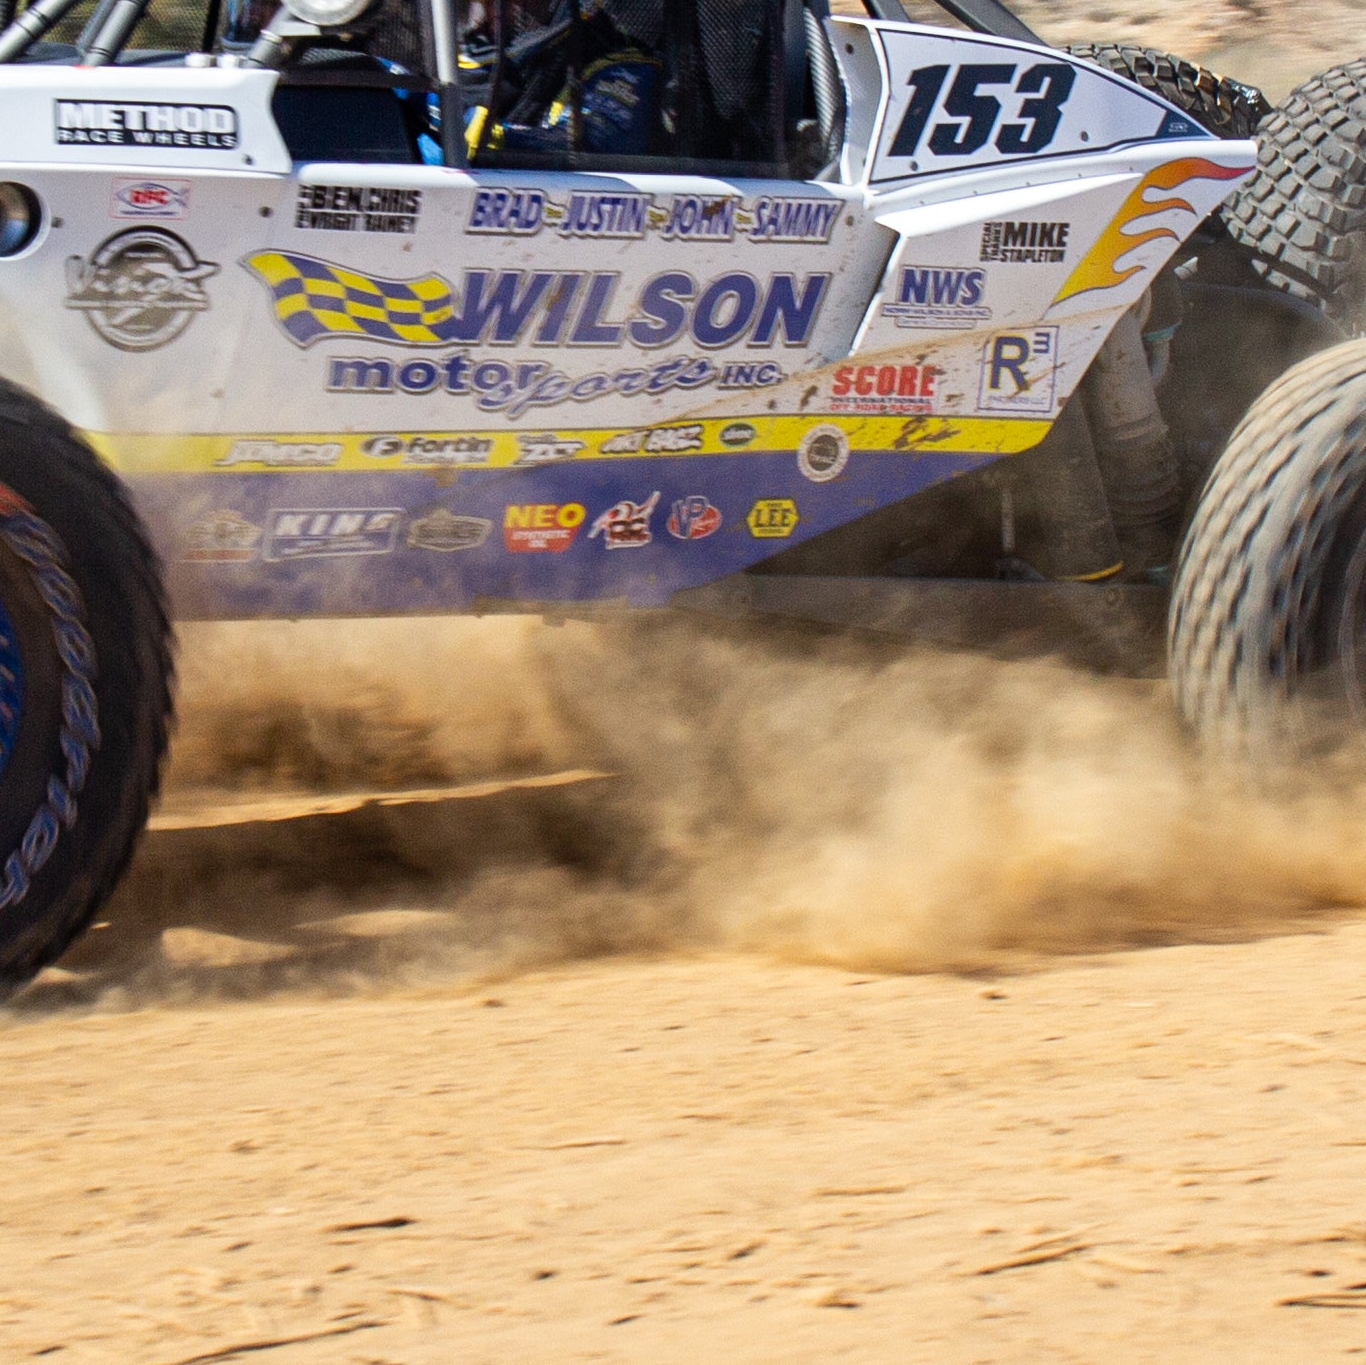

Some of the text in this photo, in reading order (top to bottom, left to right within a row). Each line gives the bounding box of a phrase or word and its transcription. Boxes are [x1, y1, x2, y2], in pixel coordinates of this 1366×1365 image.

[57, 102, 236, 134] METHOD
[888, 63, 1077, 157] 153
[58, 129, 236, 147] RACE WHEELS
[469, 190, 837, 239] BRAD JUSTIN JOHN SAMMY
[1002, 221, 1069, 247] MIKE
[1000, 249, 1066, 263] STAPLETON
[900, 268, 985, 306] NWS
[453, 270, 831, 348] WILSON
[718, 361, 784, 388] INC.
[832, 365, 936, 396] SCORE
[504, 502, 587, 529] NEO
[754, 508, 792, 528] LEE
